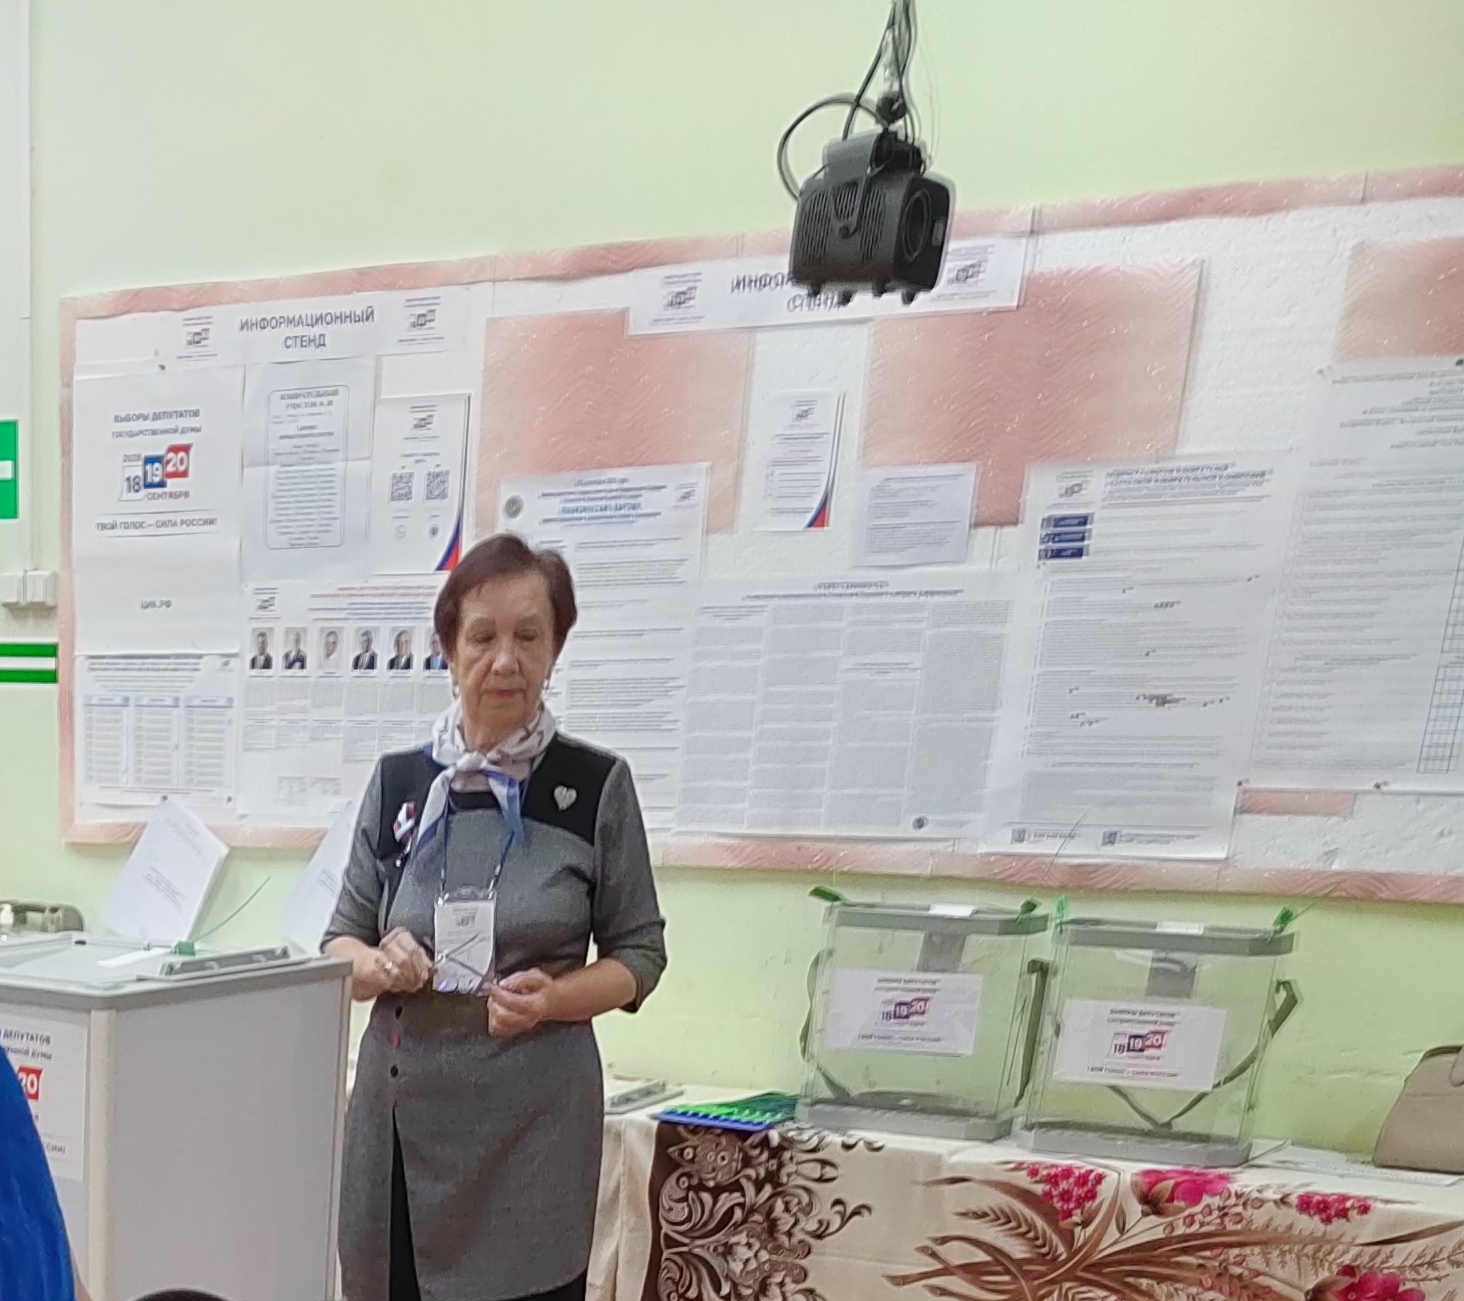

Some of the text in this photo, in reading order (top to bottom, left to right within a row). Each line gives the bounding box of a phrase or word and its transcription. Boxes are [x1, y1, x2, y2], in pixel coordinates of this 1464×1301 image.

[239, 305, 374, 332] ИНФОРМАЦИОННЫЙ
[283, 333, 326, 349] СТЕНД
[114, 409, 200, 423] ВЫБОРЫ ДЕПУТАТОВ
[112, 426, 179, 438] ГОСУДАРСТВЕННОЙ
[125, 451, 188, 493] 18 19 20
[147, 490, 190, 501] СЕНТЯБРЯ
[96, 520, 117, 531] ТВОЙ
[120, 521, 145, 530] ГОЛОС
[156, 519, 177, 530] СИЛА
[3, 1030, 50, 1044] ДЕПУТАТОВ
